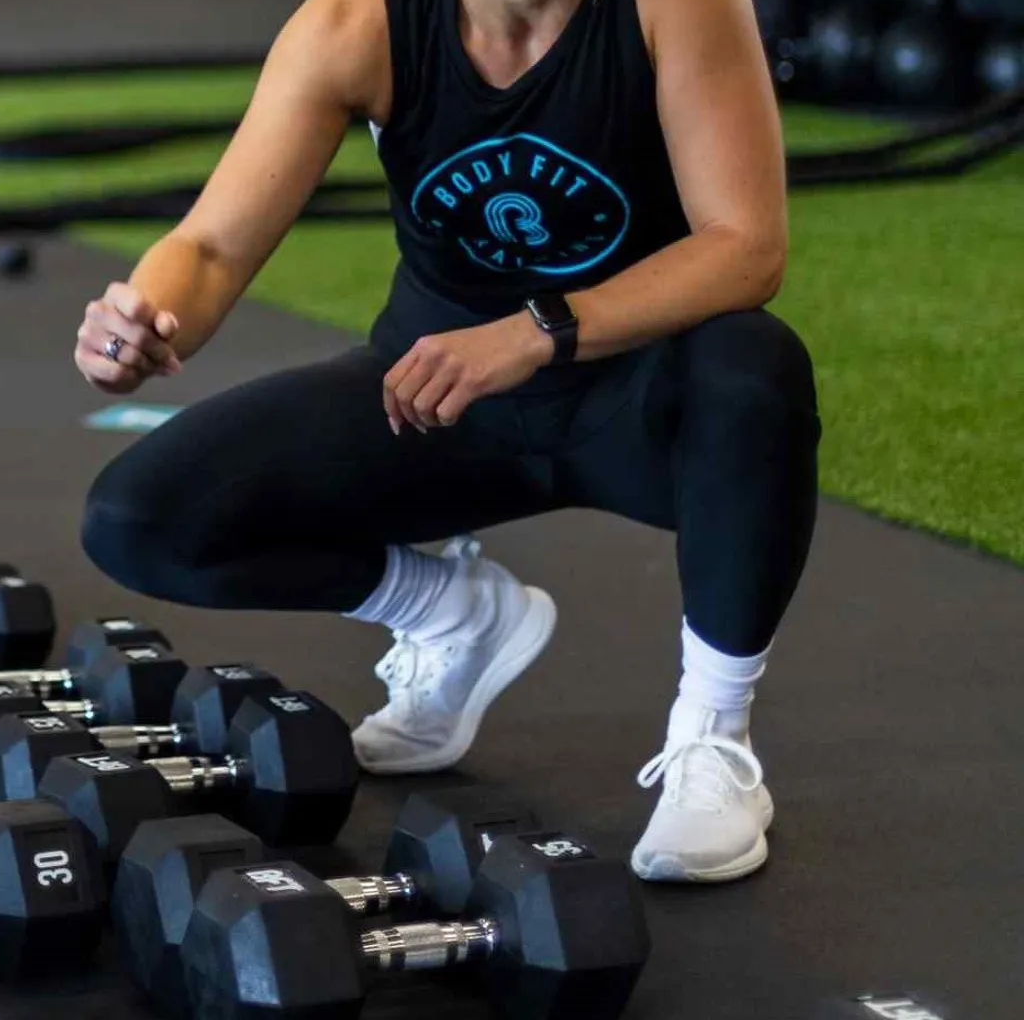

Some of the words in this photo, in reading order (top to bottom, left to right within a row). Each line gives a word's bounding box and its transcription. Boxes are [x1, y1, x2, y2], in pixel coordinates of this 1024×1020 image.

[433, 151, 512, 209] BODY
[530, 154, 588, 197] FIT
[34, 850, 72, 886] 30
